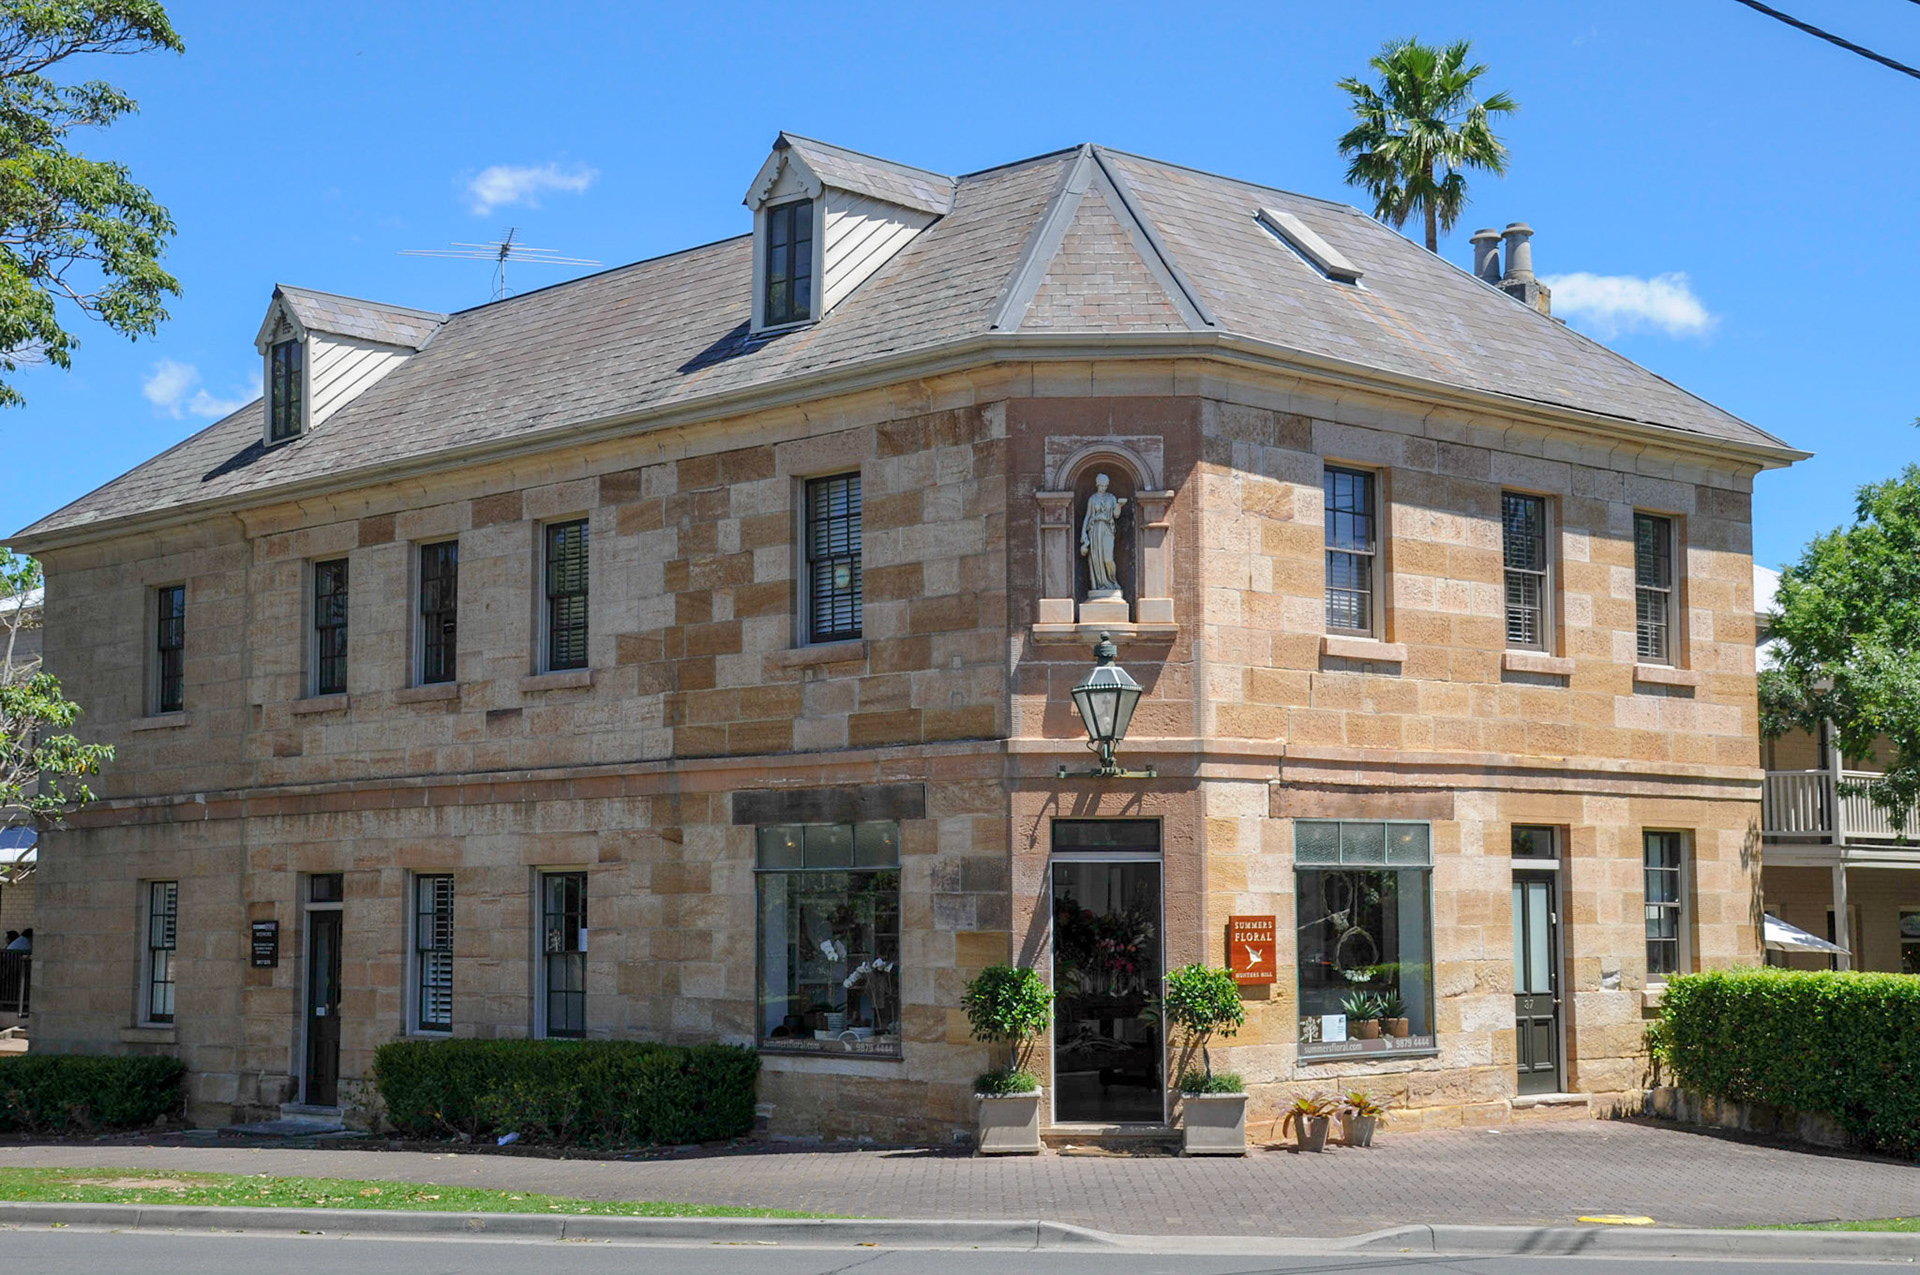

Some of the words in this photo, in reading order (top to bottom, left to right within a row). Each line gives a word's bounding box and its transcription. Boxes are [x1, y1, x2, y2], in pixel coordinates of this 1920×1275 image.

[1234, 921, 1273, 930] SUMMERS
[1234, 932, 1273, 942] FLORAL
[1524, 999, 1534, 1010] 37
[855, 1042, 874, 1053] 9879
[875, 1043, 893, 1053] 4444
[1304, 1042, 1363, 1054] summersfloral.com
[1395, 1038, 1412, 1049] 9879
[1413, 1037, 1430, 1047] 4444
